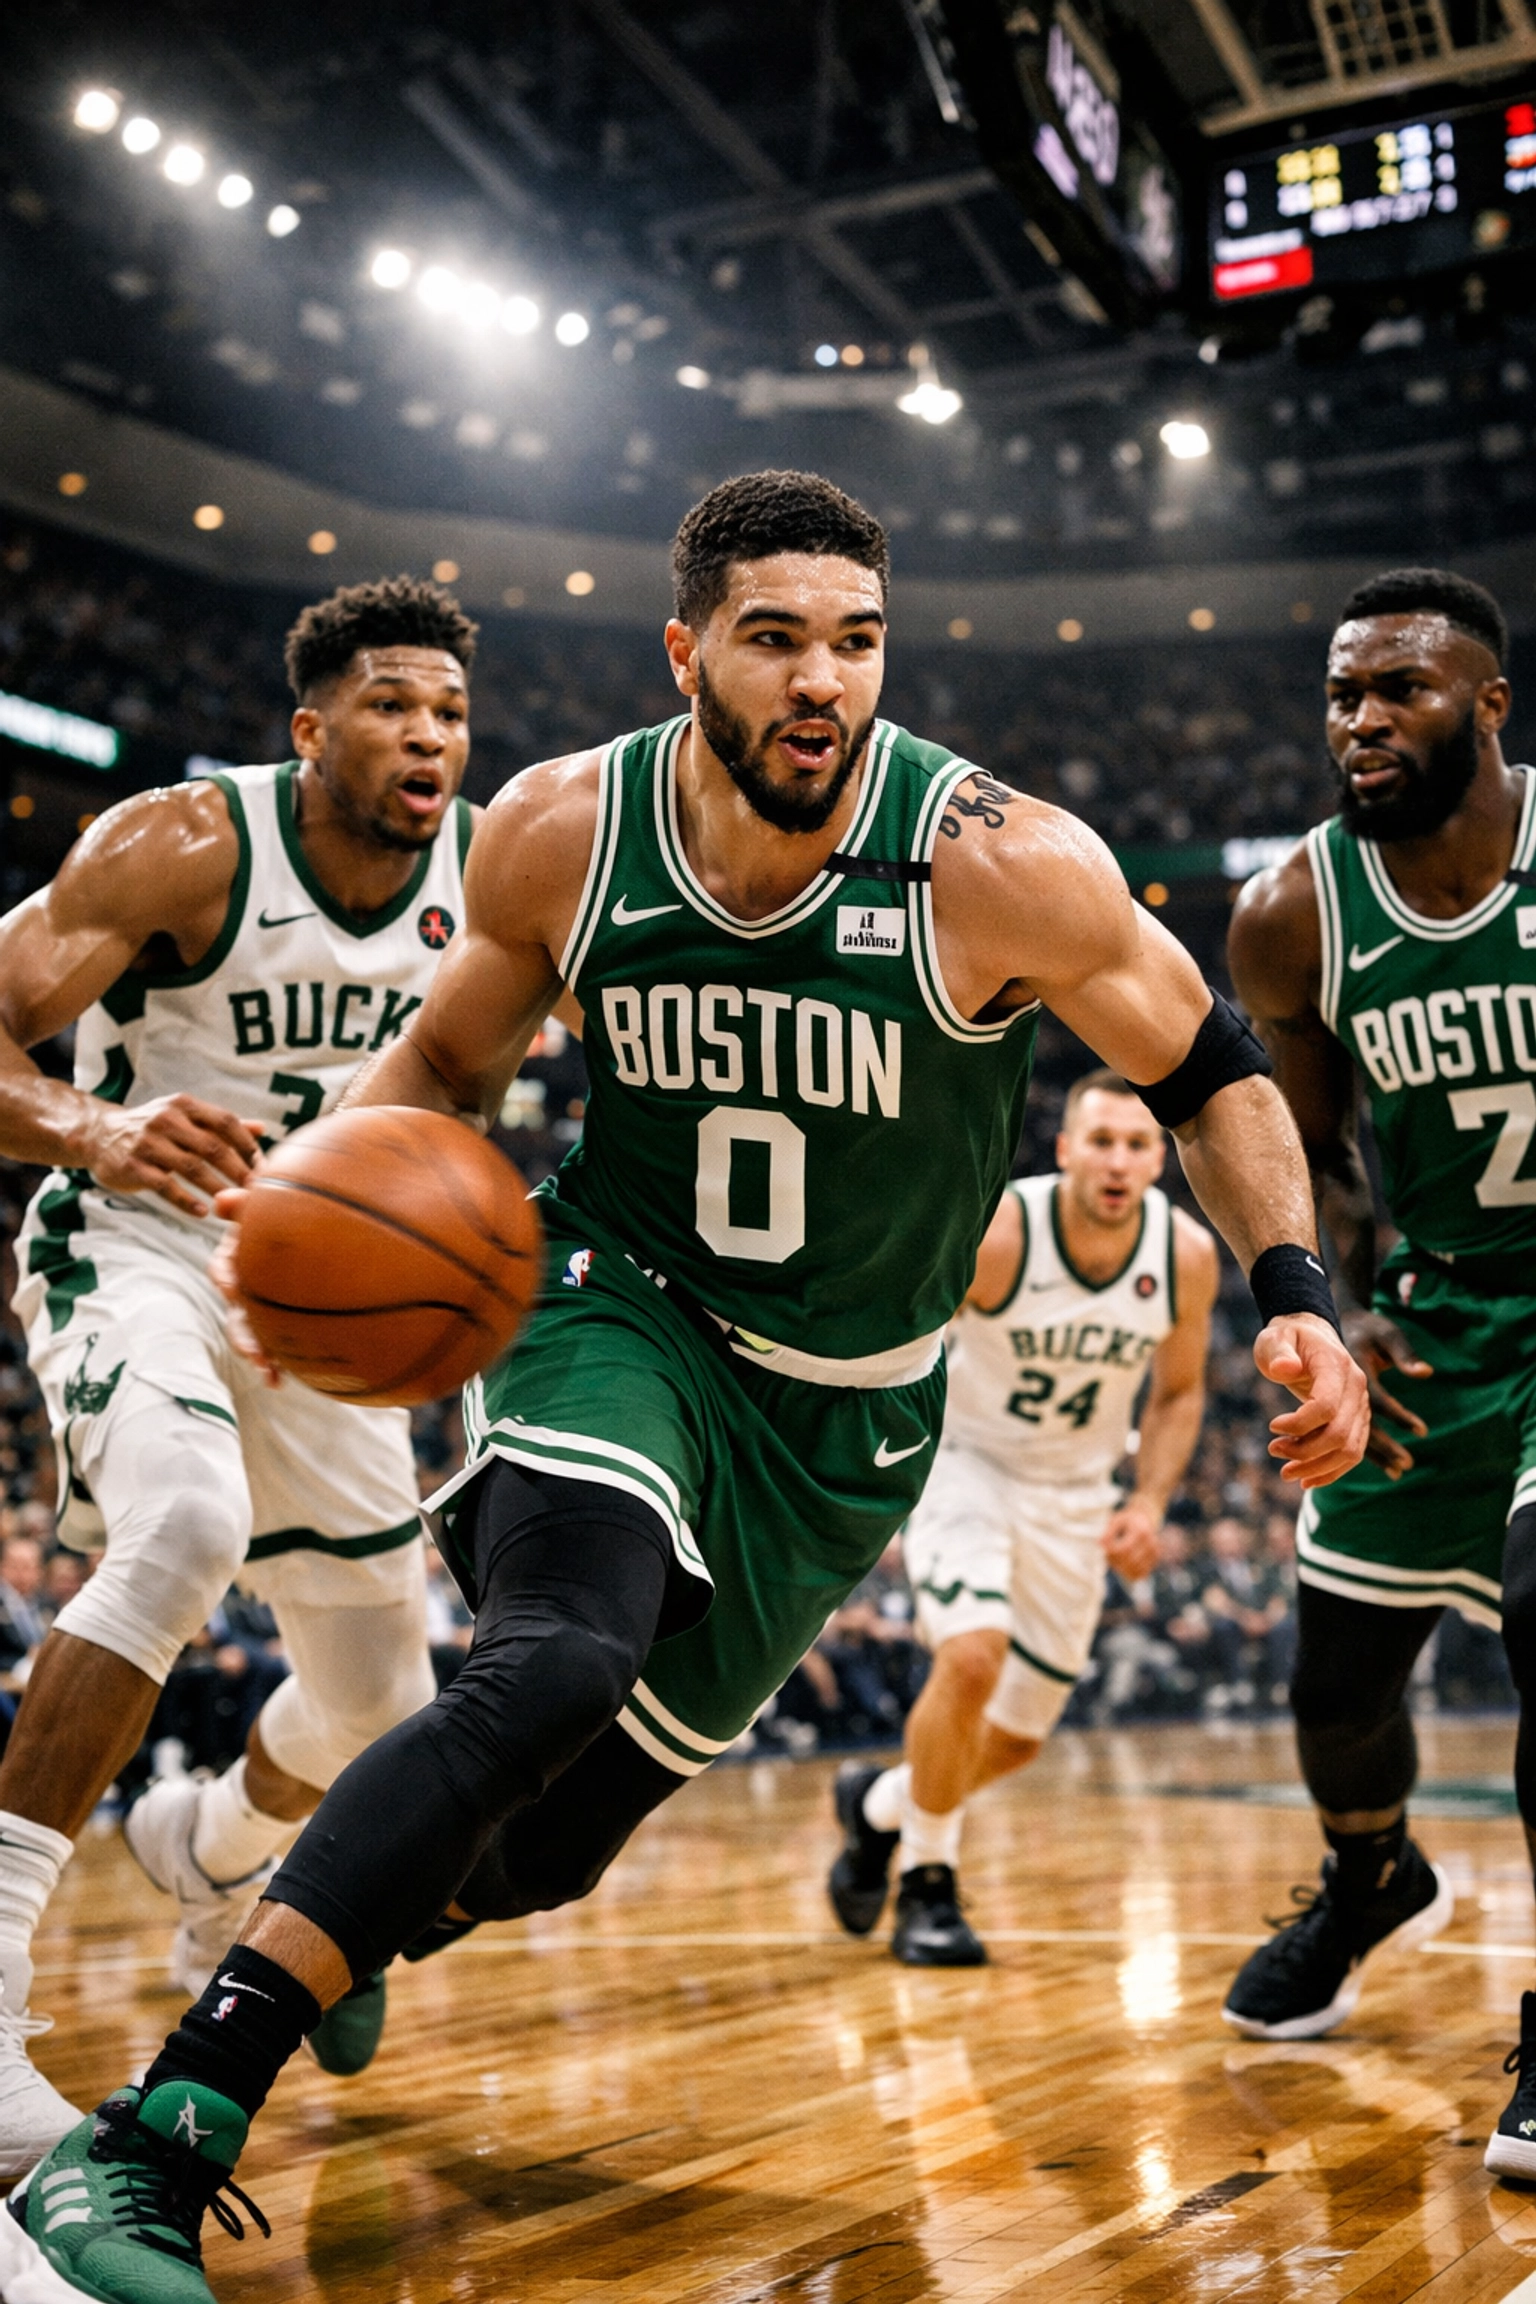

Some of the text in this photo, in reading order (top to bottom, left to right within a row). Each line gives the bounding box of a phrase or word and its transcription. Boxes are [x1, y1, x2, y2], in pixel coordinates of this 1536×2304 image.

[228, 982, 423, 1056] BUCK
[602, 984, 901, 1119] BOSTON
[1351, 984, 1536, 1093] BOSTO
[695, 1106, 806, 1263] 0
[1006, 1368, 1103, 1430] 24
